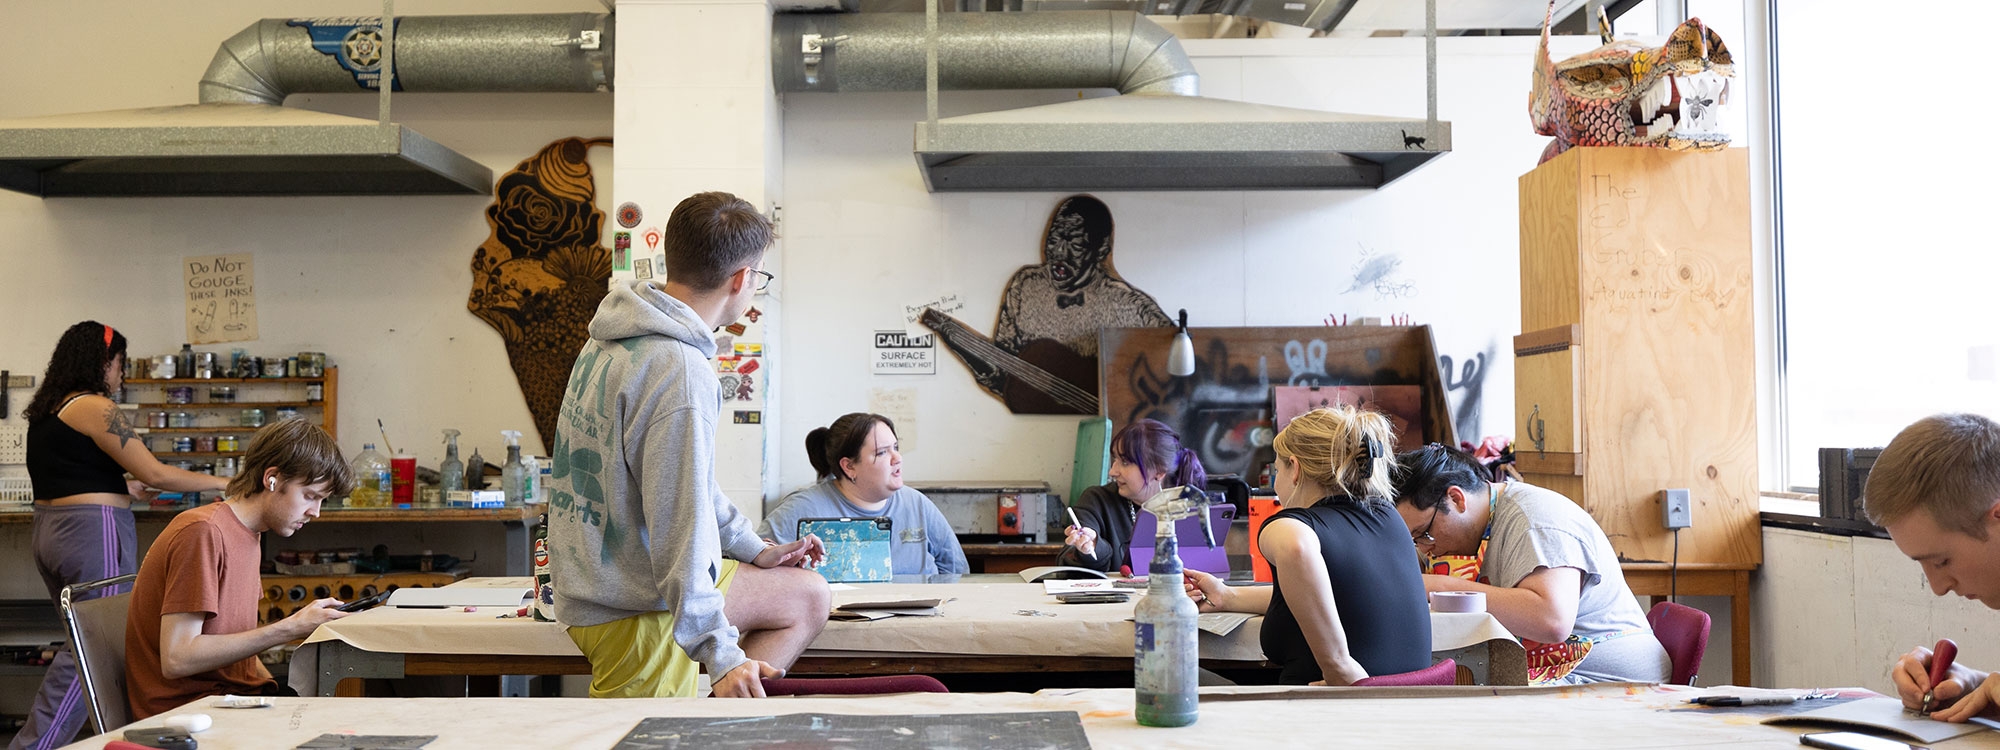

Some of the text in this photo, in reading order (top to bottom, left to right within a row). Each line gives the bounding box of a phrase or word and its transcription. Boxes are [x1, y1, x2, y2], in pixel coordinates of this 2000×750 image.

[1591, 174, 1641, 199] The
[1590, 202, 1630, 228] Ed
[1591, 232, 1690, 266] Gruber
[214, 257, 246, 273] NOT
[189, 274, 246, 288] GOUGE
[190, 285, 252, 301] THESE INKS!
[1592, 277, 1673, 307] Aquatint
[877, 335, 931, 346] CAUTION
[881, 352, 926, 360] SURFACE
